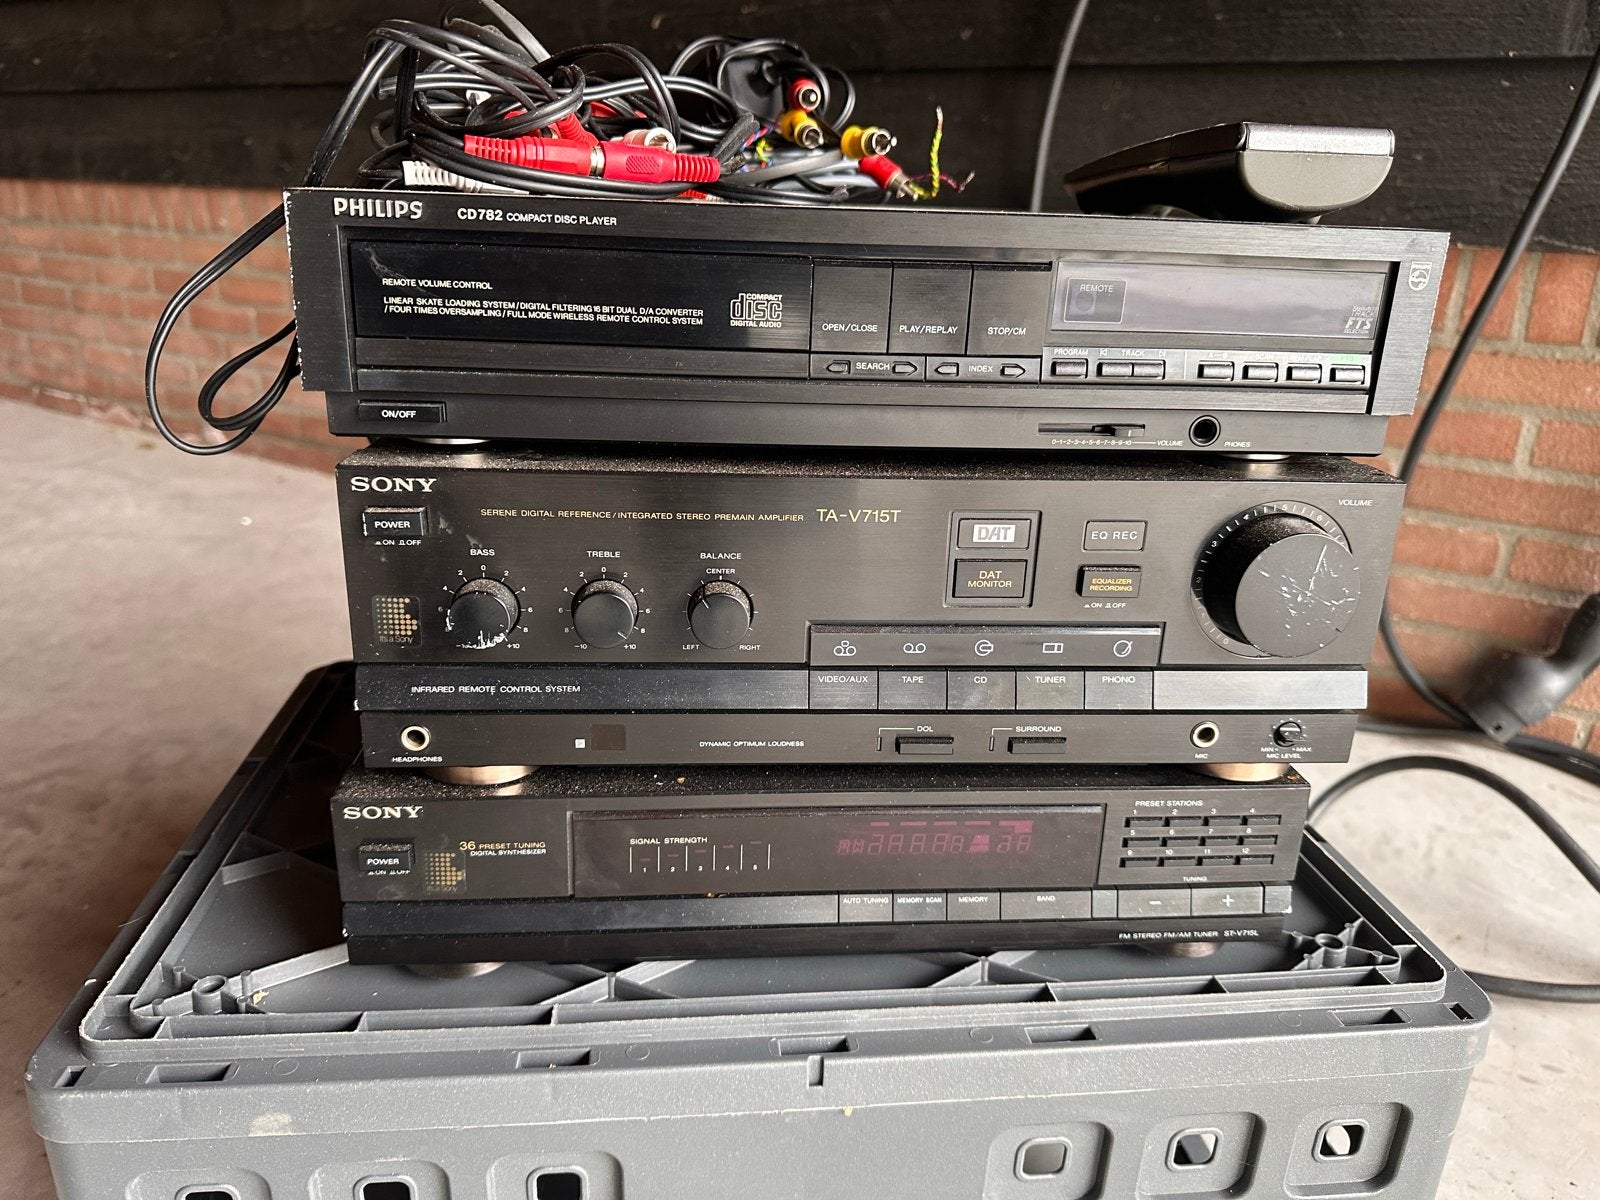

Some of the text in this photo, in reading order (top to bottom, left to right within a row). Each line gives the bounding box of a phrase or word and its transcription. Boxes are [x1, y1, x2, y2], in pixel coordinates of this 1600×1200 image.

[334, 198, 422, 219] PHILIPS
[457, 208, 617, 226] CD782 COMPACT DISC PLAYER
[382, 278, 493, 290] REMOTE VOLUME CONTROL
[1080, 284, 1113, 292] REMOTE
[746, 293, 782, 301] COMPACT
[384, 297, 413, 305] LINEAR
[416, 298, 442, 306] SKATE
[445, 299, 480, 307] LOADING
[552, 303, 592, 312] FILTERING
[617, 306, 637, 314] DUAL
[640, 307, 654, 315] D/A
[656, 308, 704, 317] CONVERTER
[390, 306, 412, 314] FOUR
[528, 311, 551, 319] MODE
[554, 312, 594, 322] WIRELESS
[597, 314, 630, 323] REMOTE
[632, 316, 670, 324] CONTROL
[672, 317, 703, 325] SYSTEM
[822, 323, 878, 332] OPEN/CLOSE
[1345, 317, 1373, 329] FTS
[899, 325, 958, 334] PLAY/REPLAY
[987, 327, 1026, 335] STOP/CM
[856, 362, 890, 371] SEARCH
[381, 409, 416, 418] ON/OFF
[351, 476, 437, 492] SONY
[1338, 499, 1373, 507] VOLUME
[481, 509, 517, 517] SERENE
[714, 513, 754, 521] PREMAIN
[758, 514, 804, 522] AMPLIFIER
[816, 509, 901, 523] TA-V715T
[374, 521, 411, 529] POWER
[977, 526, 1011, 541] DAT
[1091, 531, 1138, 540] EQ REC
[700, 552, 742, 560] BALANCE
[979, 571, 1002, 579] DAT
[967, 580, 1012, 588] MONITOR
[395, 635, 413, 644] Sony
[818, 675, 868, 683] VIDEO/AUX
[902, 675, 924, 683] TAPE
[343, 806, 423, 819] SONY
[459, 841, 546, 851] 36 PRESET TUNING
